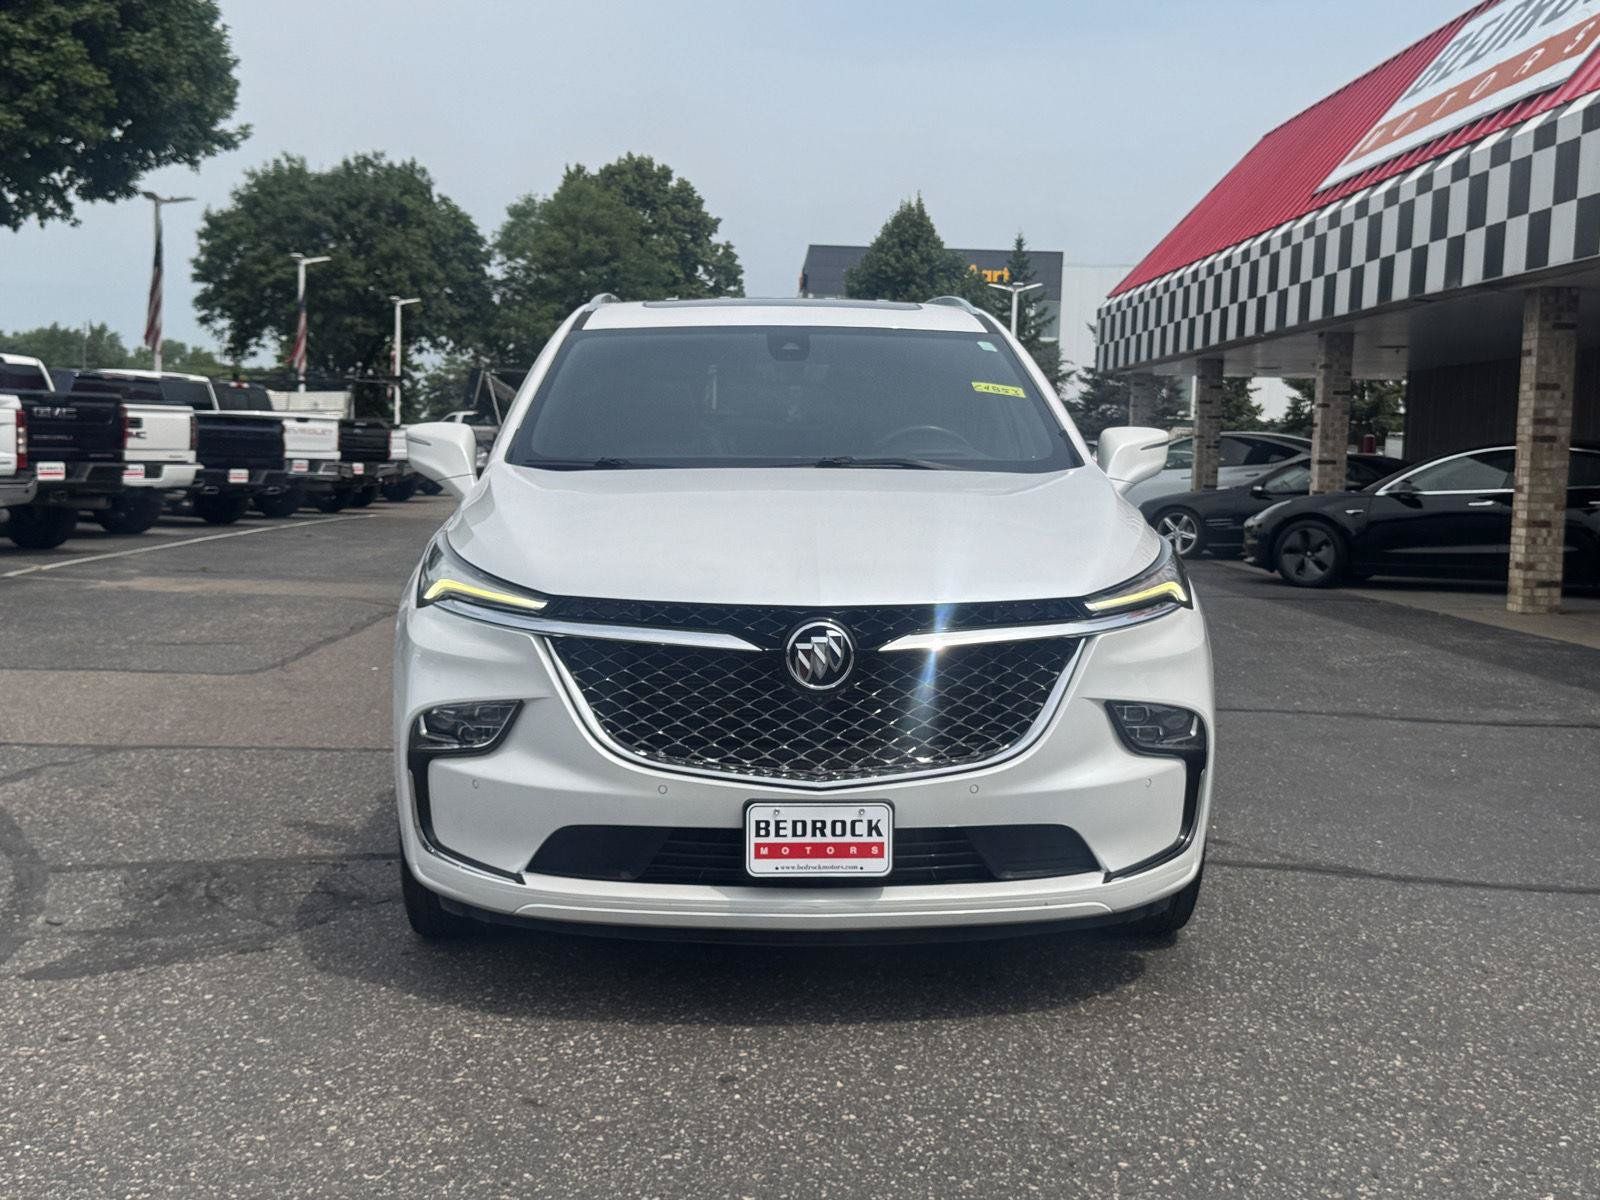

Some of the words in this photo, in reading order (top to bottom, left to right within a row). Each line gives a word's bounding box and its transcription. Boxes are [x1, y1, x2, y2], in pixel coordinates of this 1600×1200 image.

[1359, 21, 1596, 153] MOTORS
[754, 819, 884, 838] BEDROCK
[760, 846, 879, 855] MOTORS
